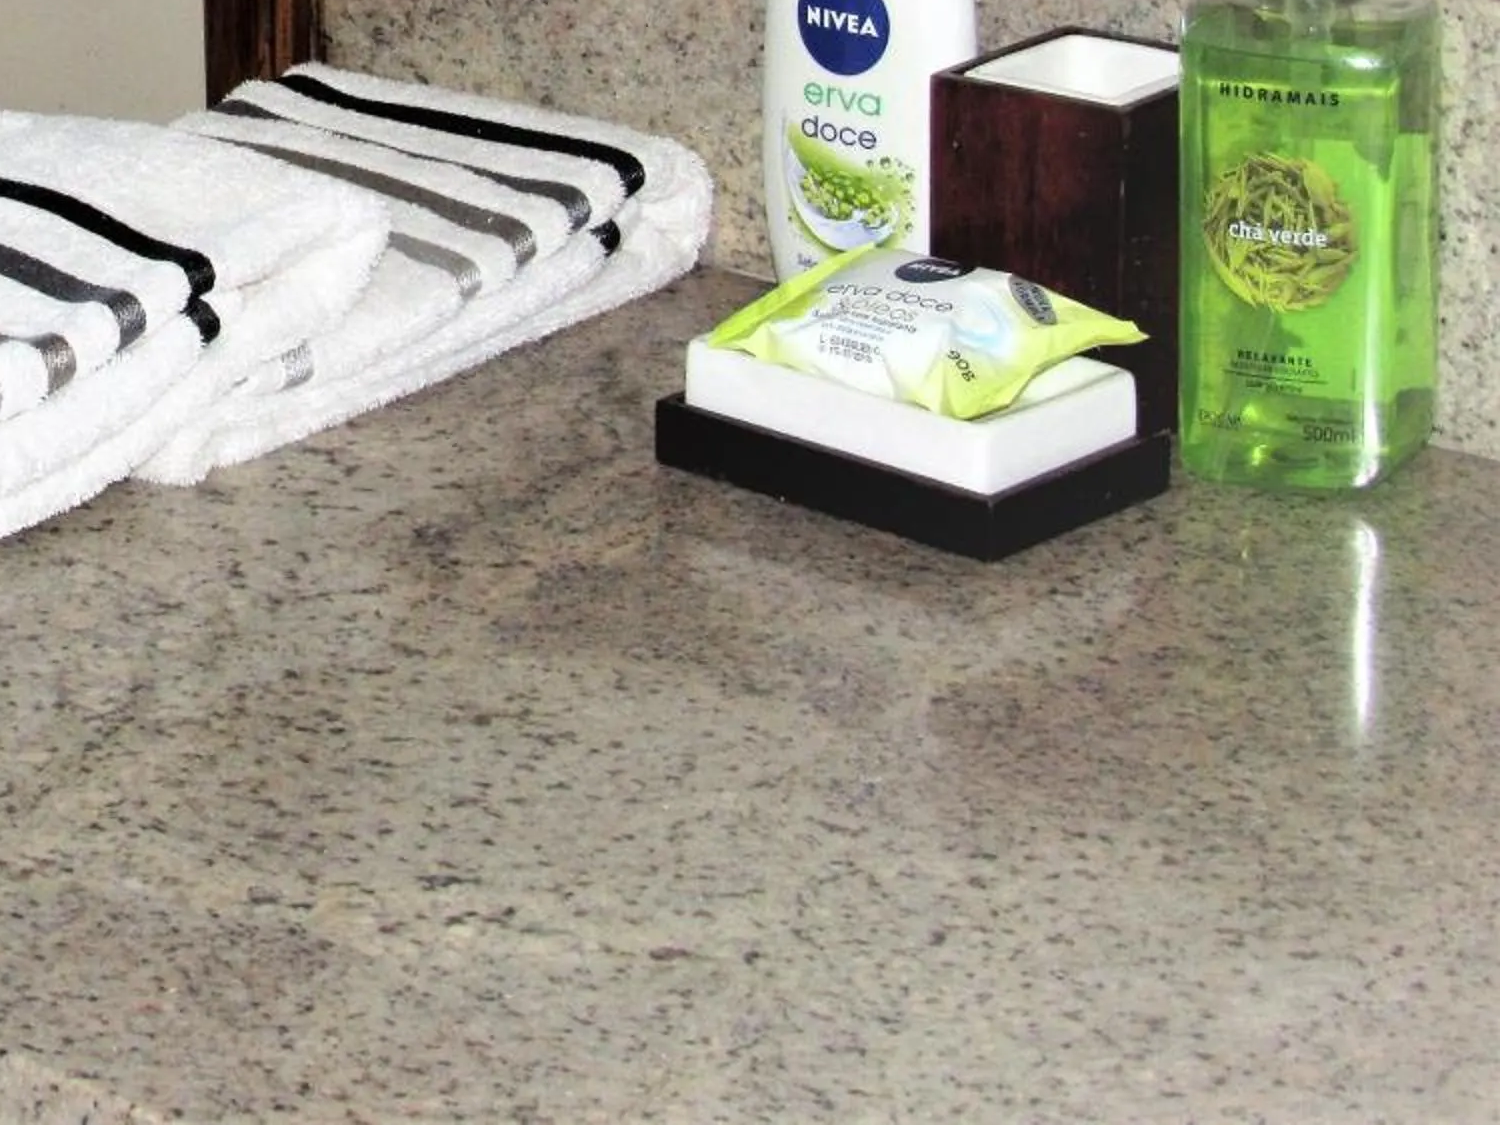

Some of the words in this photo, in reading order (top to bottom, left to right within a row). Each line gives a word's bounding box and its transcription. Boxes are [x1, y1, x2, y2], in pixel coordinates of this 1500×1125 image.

[806, 4, 880, 38] NIVEA
[803, 81, 882, 117] erva
[1219, 82, 1341, 107] HIDRAMAIS
[800, 114, 878, 150] doce
[1228, 220, 1264, 241] chá
[1269, 227, 1328, 248] verde
[826, 283, 883, 297] erva
[885, 288, 954, 313] doce
[947, 349, 976, 383] 90g
[1302, 425, 1356, 444] 500ml
